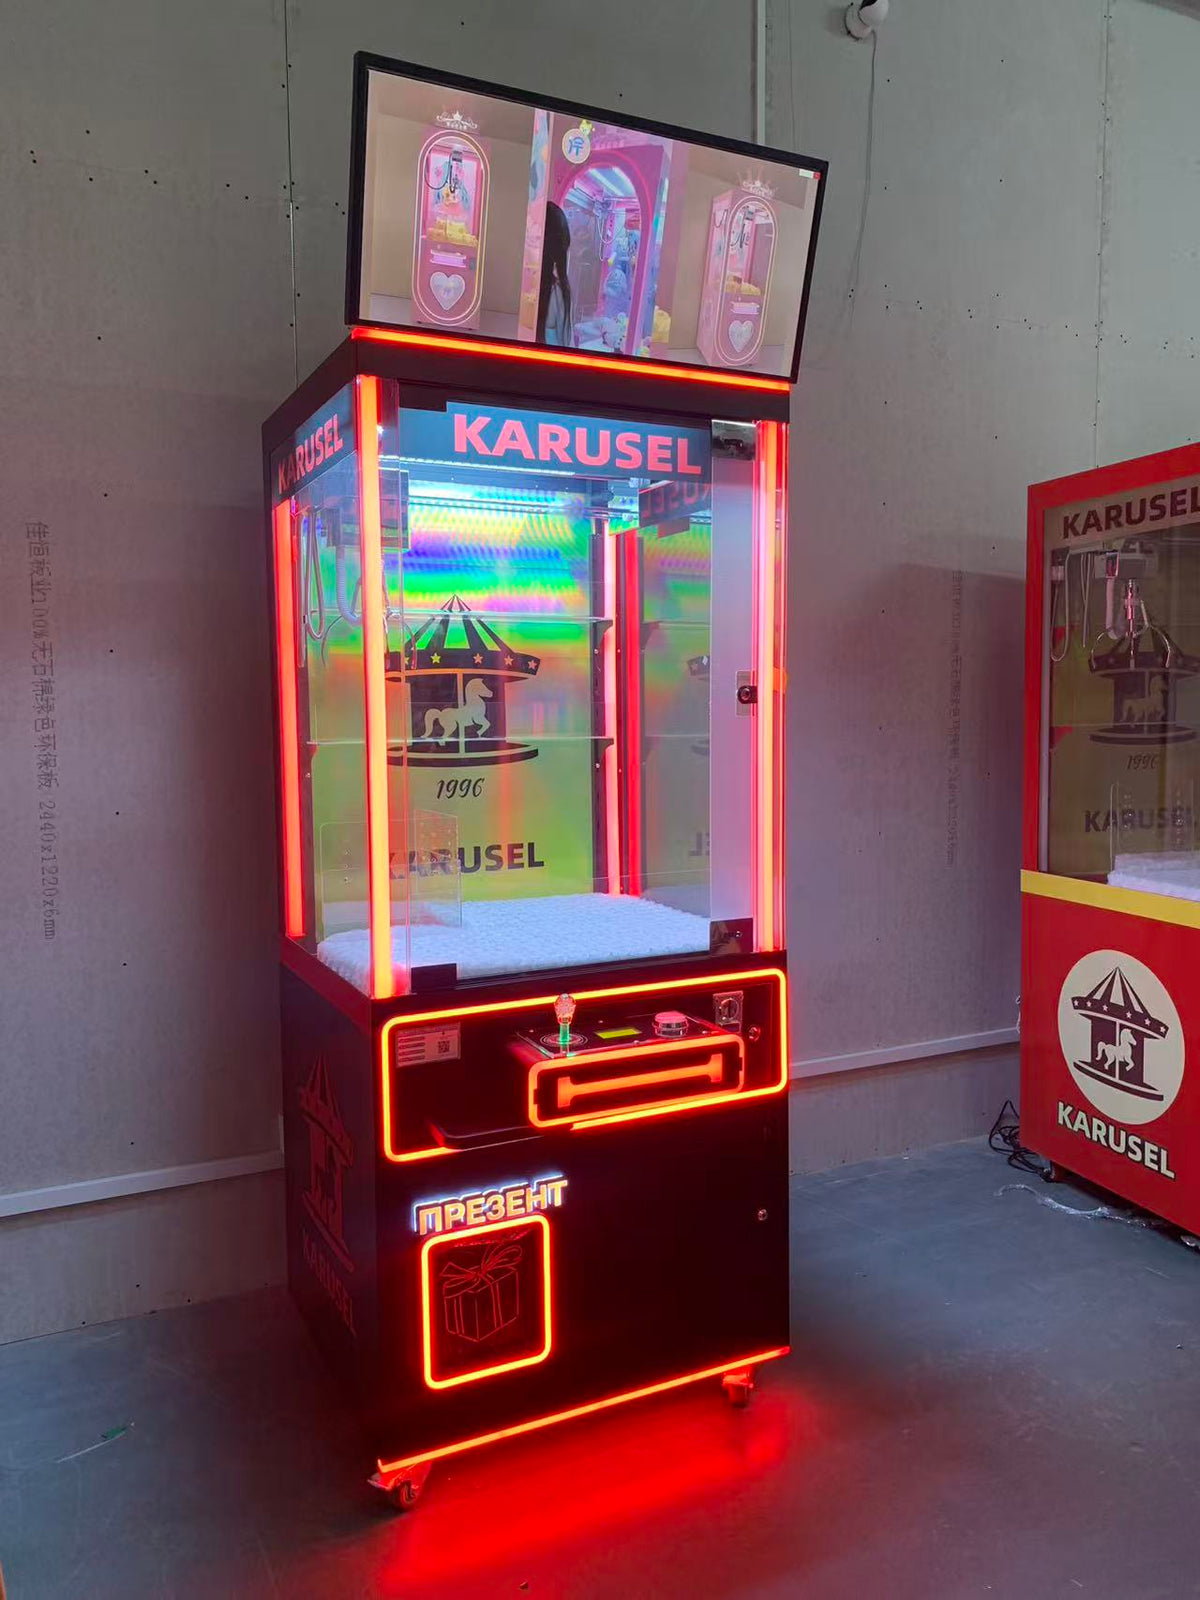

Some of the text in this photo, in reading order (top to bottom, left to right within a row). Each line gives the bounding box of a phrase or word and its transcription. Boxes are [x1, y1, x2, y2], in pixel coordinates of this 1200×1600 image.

[278, 413, 344, 495] KARUSEL
[452, 413, 702, 476] KARUSEL
[1062, 486, 1200, 540] KARUSEL
[435, 777, 486, 800] 1996
[1057, 1100, 1176, 1180] KARUSEL
[416, 1177, 568, 1236] ПРЕЗЕНТ
